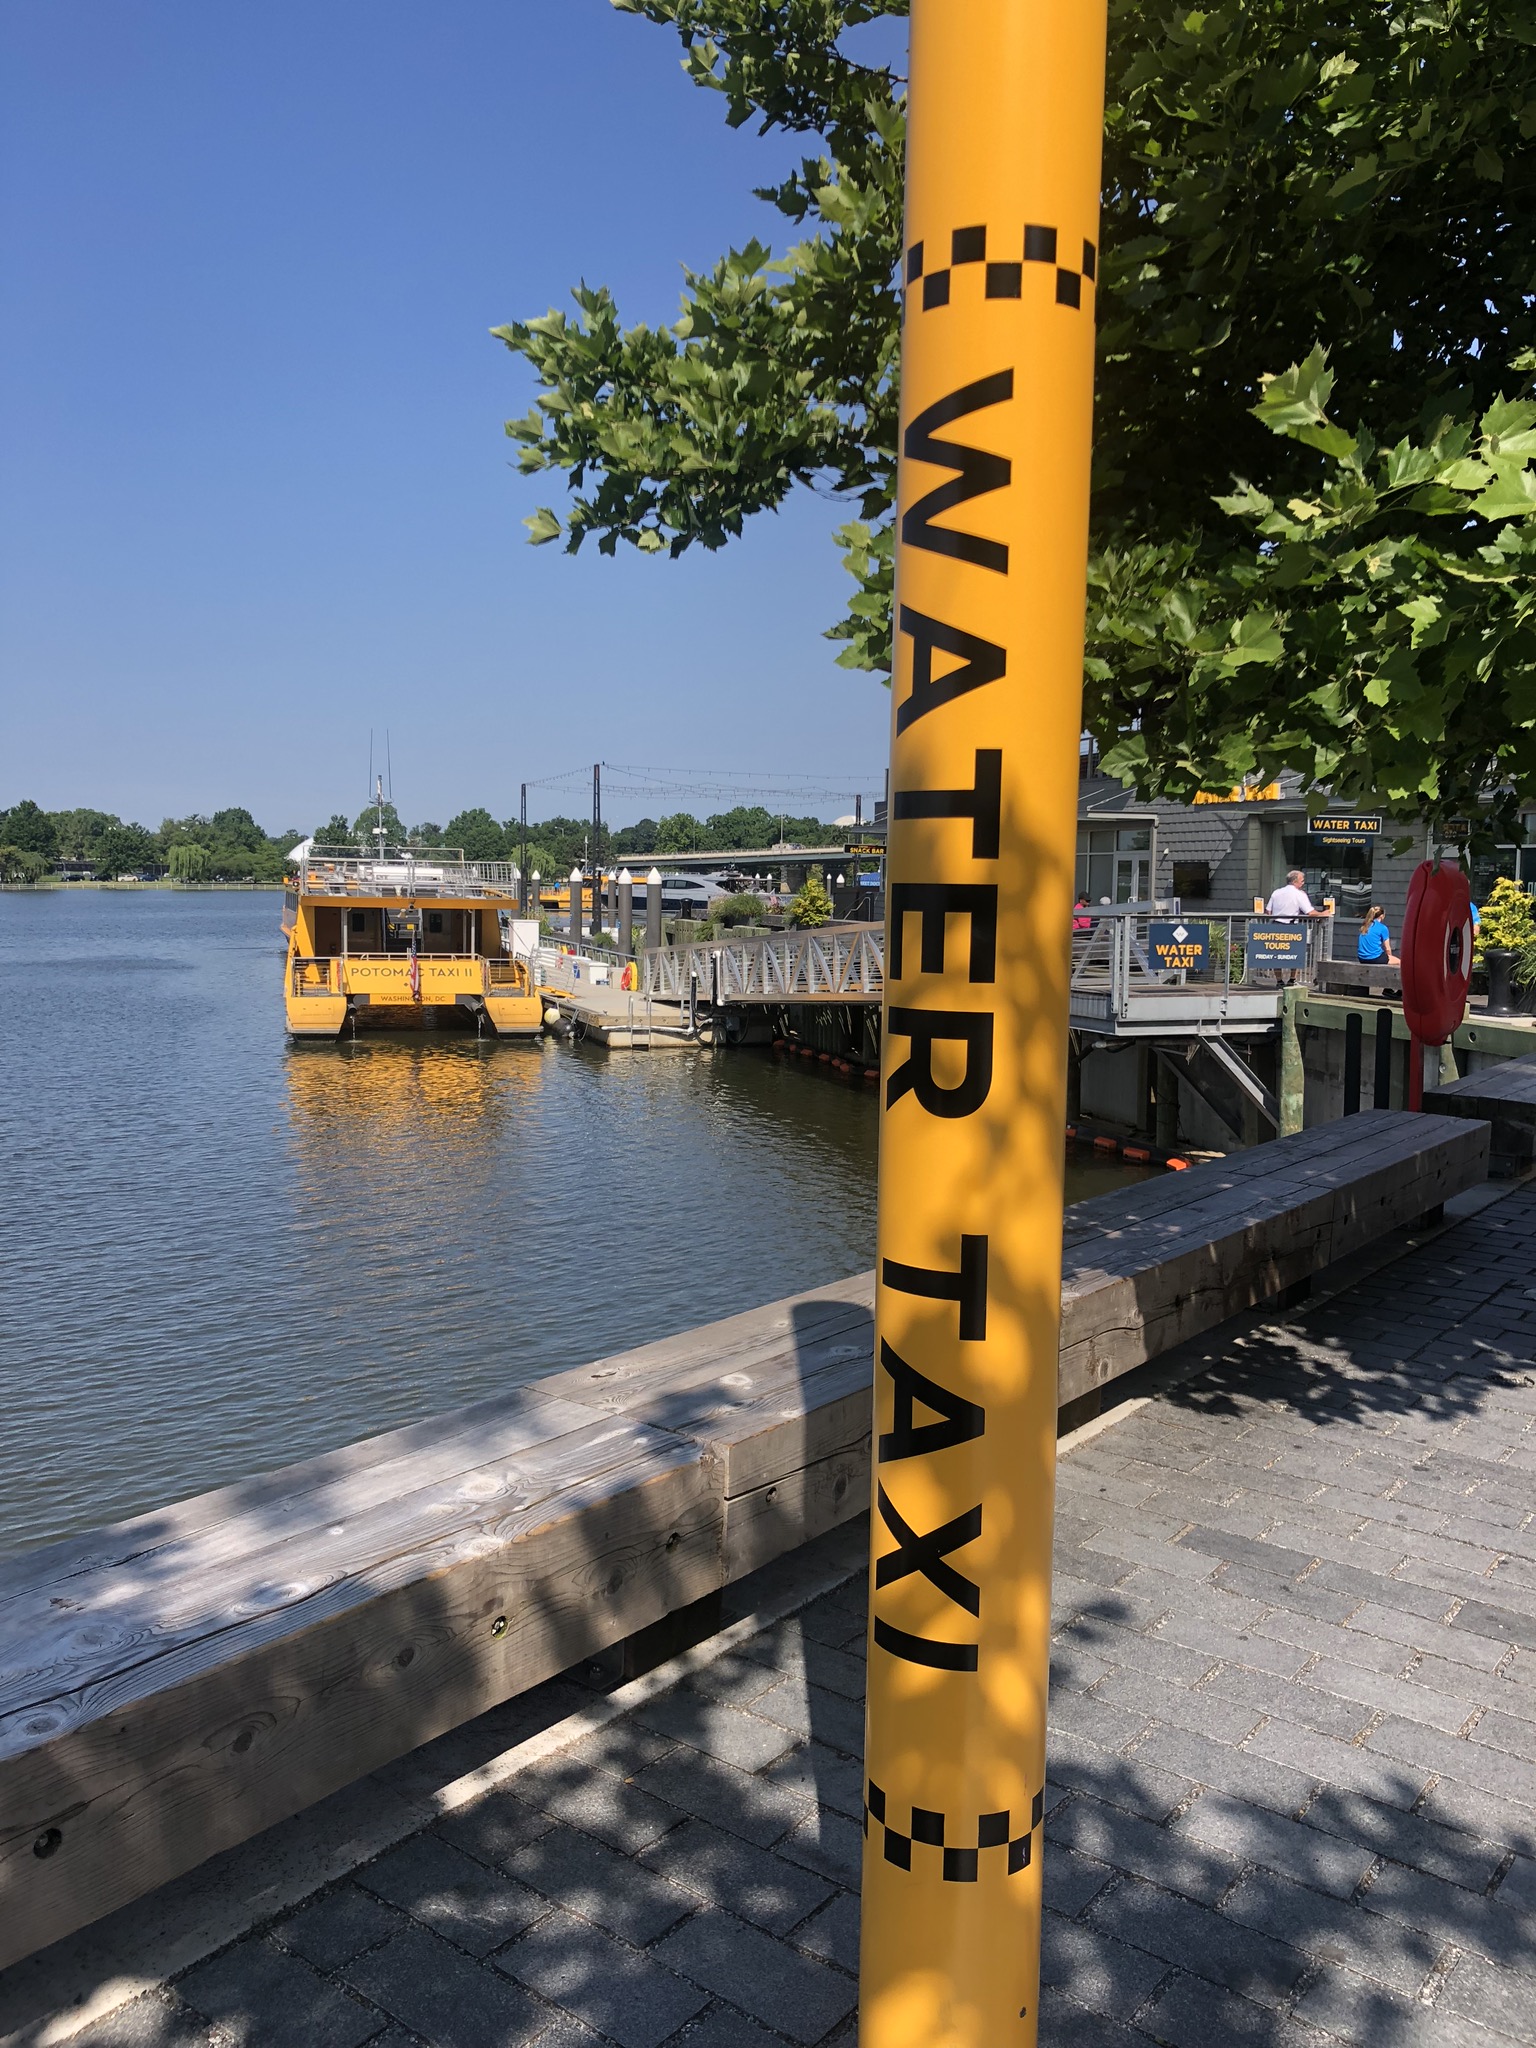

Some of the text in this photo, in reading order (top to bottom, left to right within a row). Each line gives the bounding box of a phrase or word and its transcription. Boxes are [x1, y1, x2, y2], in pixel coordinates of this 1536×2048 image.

[1313, 820, 1377, 830] WATER TAXI
[1253, 932, 1302, 941] SIGHTSEEING
[1155, 944, 1203, 955] WATER
[1264, 942, 1290, 950] TOURS
[1164, 956, 1194, 968] TAXI
[429, 968, 459, 977] TAXI
[465, 968, 472, 977] II
[874, 365, 1014, 1673] WATER TAXI
